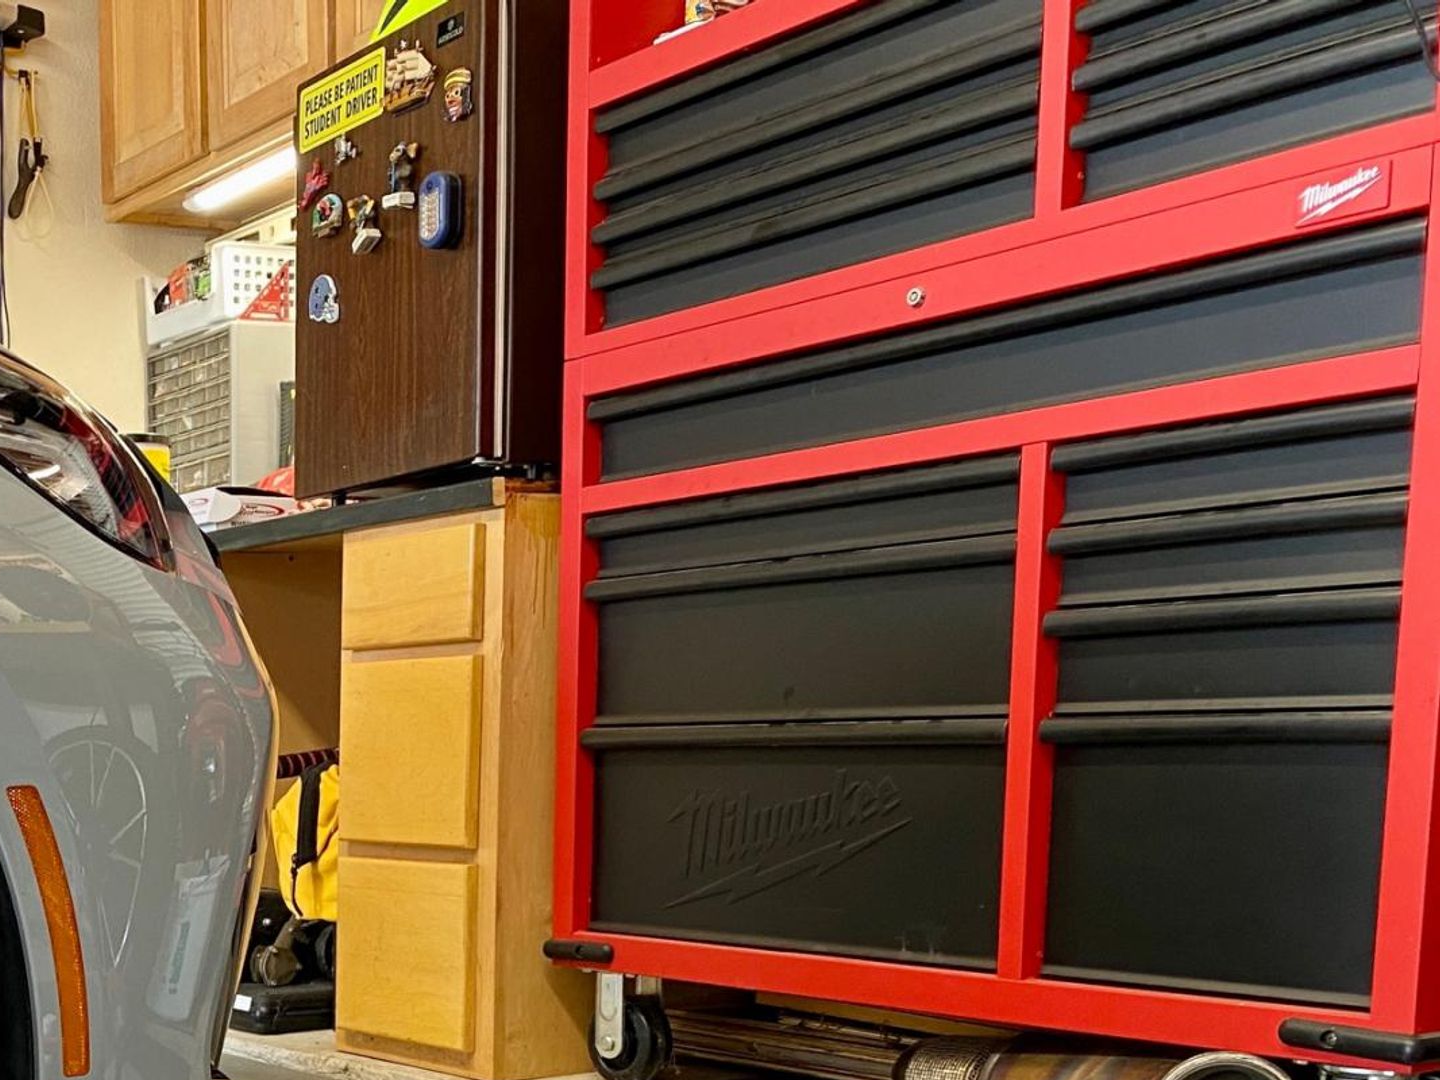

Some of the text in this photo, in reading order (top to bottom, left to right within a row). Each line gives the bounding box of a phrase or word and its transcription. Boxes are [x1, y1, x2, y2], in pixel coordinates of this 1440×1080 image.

[305, 63, 379, 117] PLEASE BE PATIENT
[305, 87, 378, 140] STUDENT DRIVER
[1298, 165, 1380, 213] Milwaukee
[666, 768, 902, 880] Milwaukee
